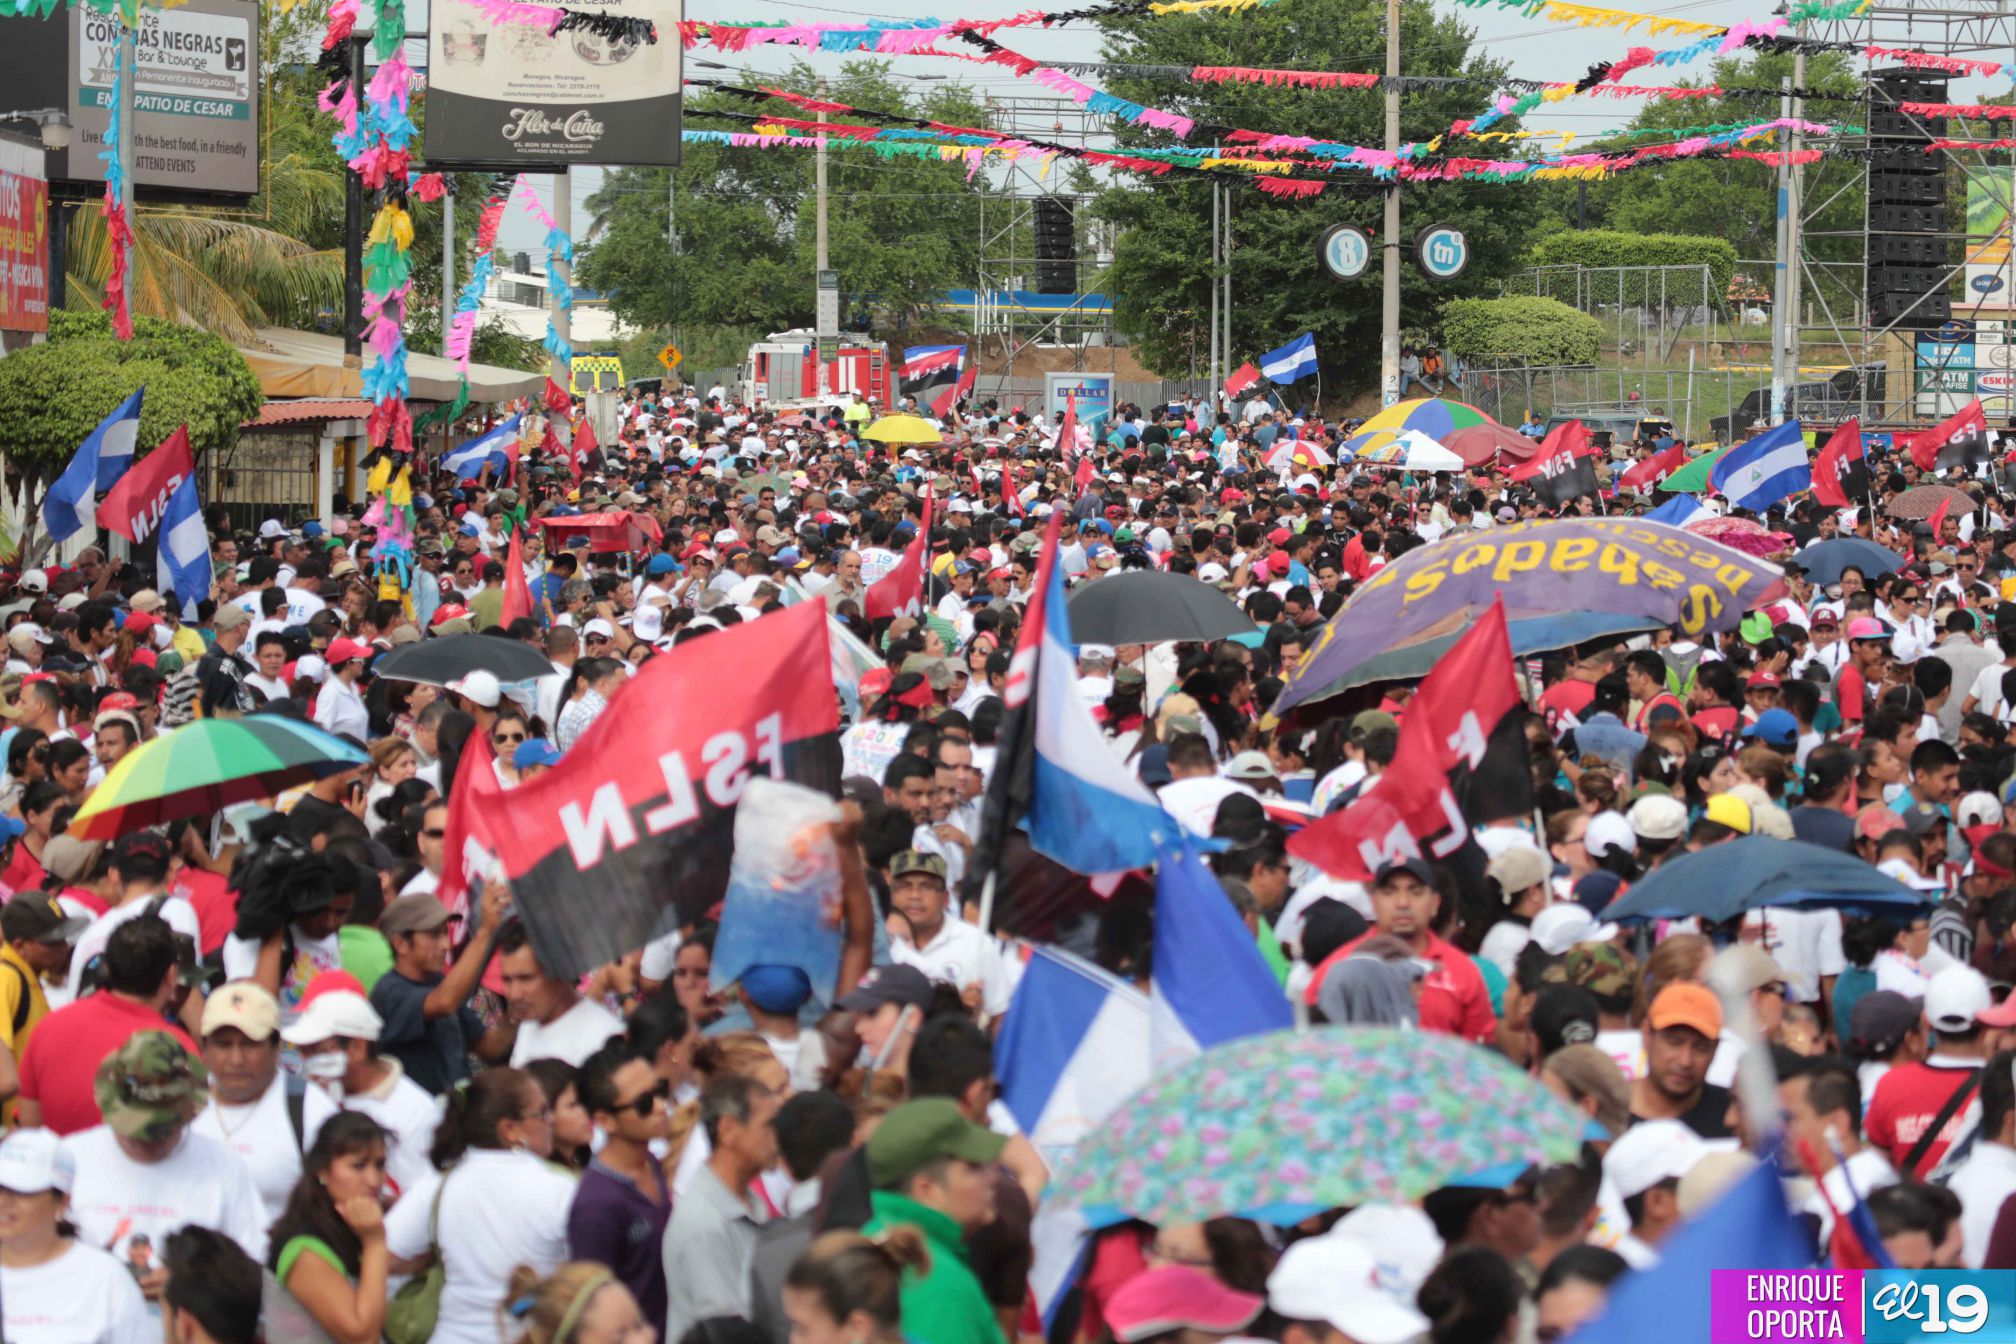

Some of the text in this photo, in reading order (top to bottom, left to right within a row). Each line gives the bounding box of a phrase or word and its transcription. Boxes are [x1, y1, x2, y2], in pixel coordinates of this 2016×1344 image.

[86, 22, 223, 54] CONAS NEGRAS
[137, 50, 207, 71] Bar & Lounge
[100, 71, 117, 84] AÑO
[134, 95, 234, 117] PATIO DE CESAR
[502, 107, 605, 142] Flor de Caña
[82, 129, 98, 143] Live
[145, 136, 159, 148] the
[160, 137, 177, 150] best
[178, 137, 199, 153] food,
[200, 139, 208, 153] in
[209, 142, 215, 153] a
[215, 140, 247, 159] friendly
[135, 156, 196, 174] ATTEND EVENTS
[1942, 372, 1969, 383] ATM
